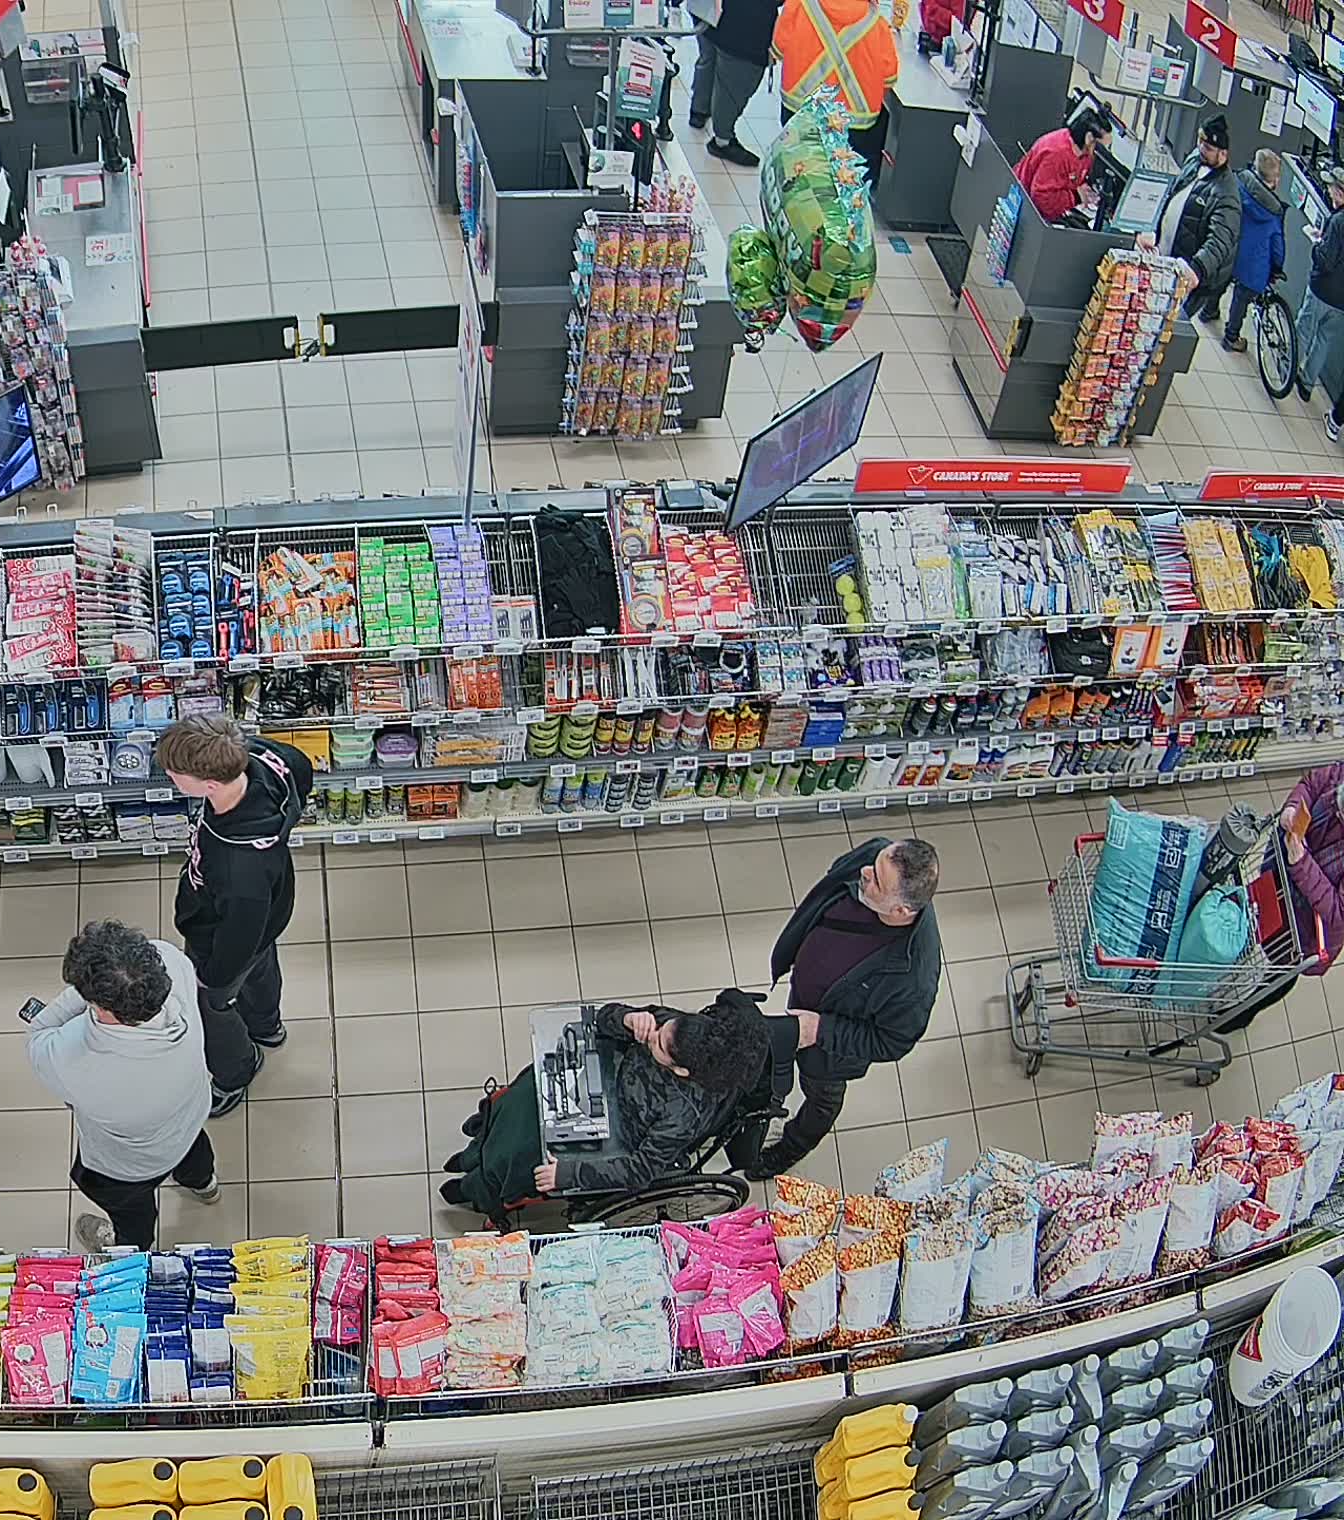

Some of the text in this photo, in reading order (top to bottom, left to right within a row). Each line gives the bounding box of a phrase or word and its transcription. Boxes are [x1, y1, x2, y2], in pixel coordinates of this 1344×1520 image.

[1202, 18, 1223, 54] 2
[933, 471, 1010, 482] CANADA'S STORE
